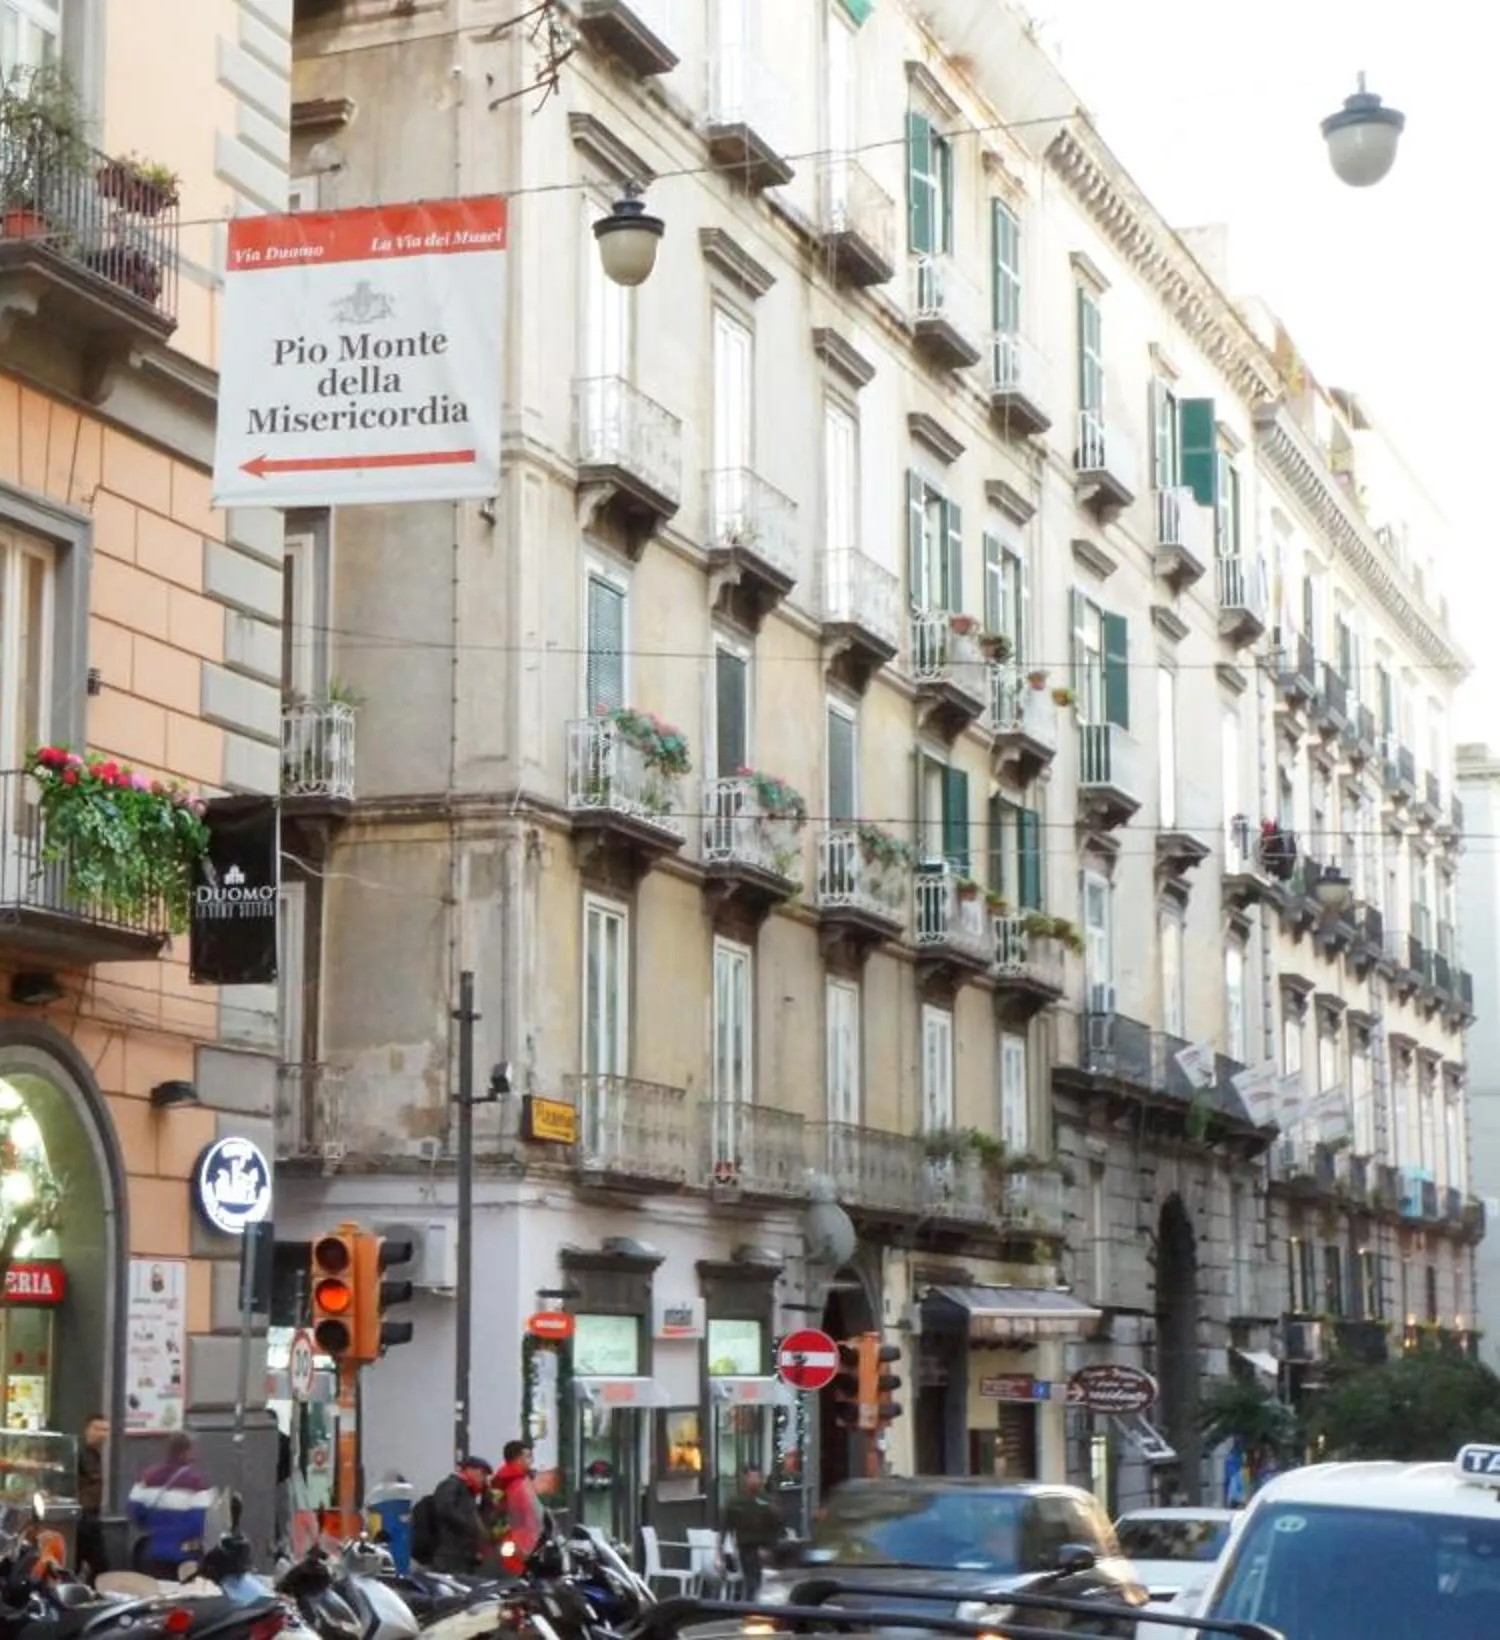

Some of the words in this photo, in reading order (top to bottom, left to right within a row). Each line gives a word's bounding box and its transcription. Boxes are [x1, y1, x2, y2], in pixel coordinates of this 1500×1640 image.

[235, 247, 261, 263] Via
[265, 244, 324, 261] Duomo
[371, 237, 393, 252] La
[398, 234, 422, 249] Via
[424, 231, 450, 248] dei
[451, 228, 502, 246] Musei
[273, 336, 328, 366] Pio
[339, 330, 448, 362] Monte
[317, 366, 402, 397] della
[245, 395, 469, 435] Misericordia
[196, 885, 274, 903] DUOMO
